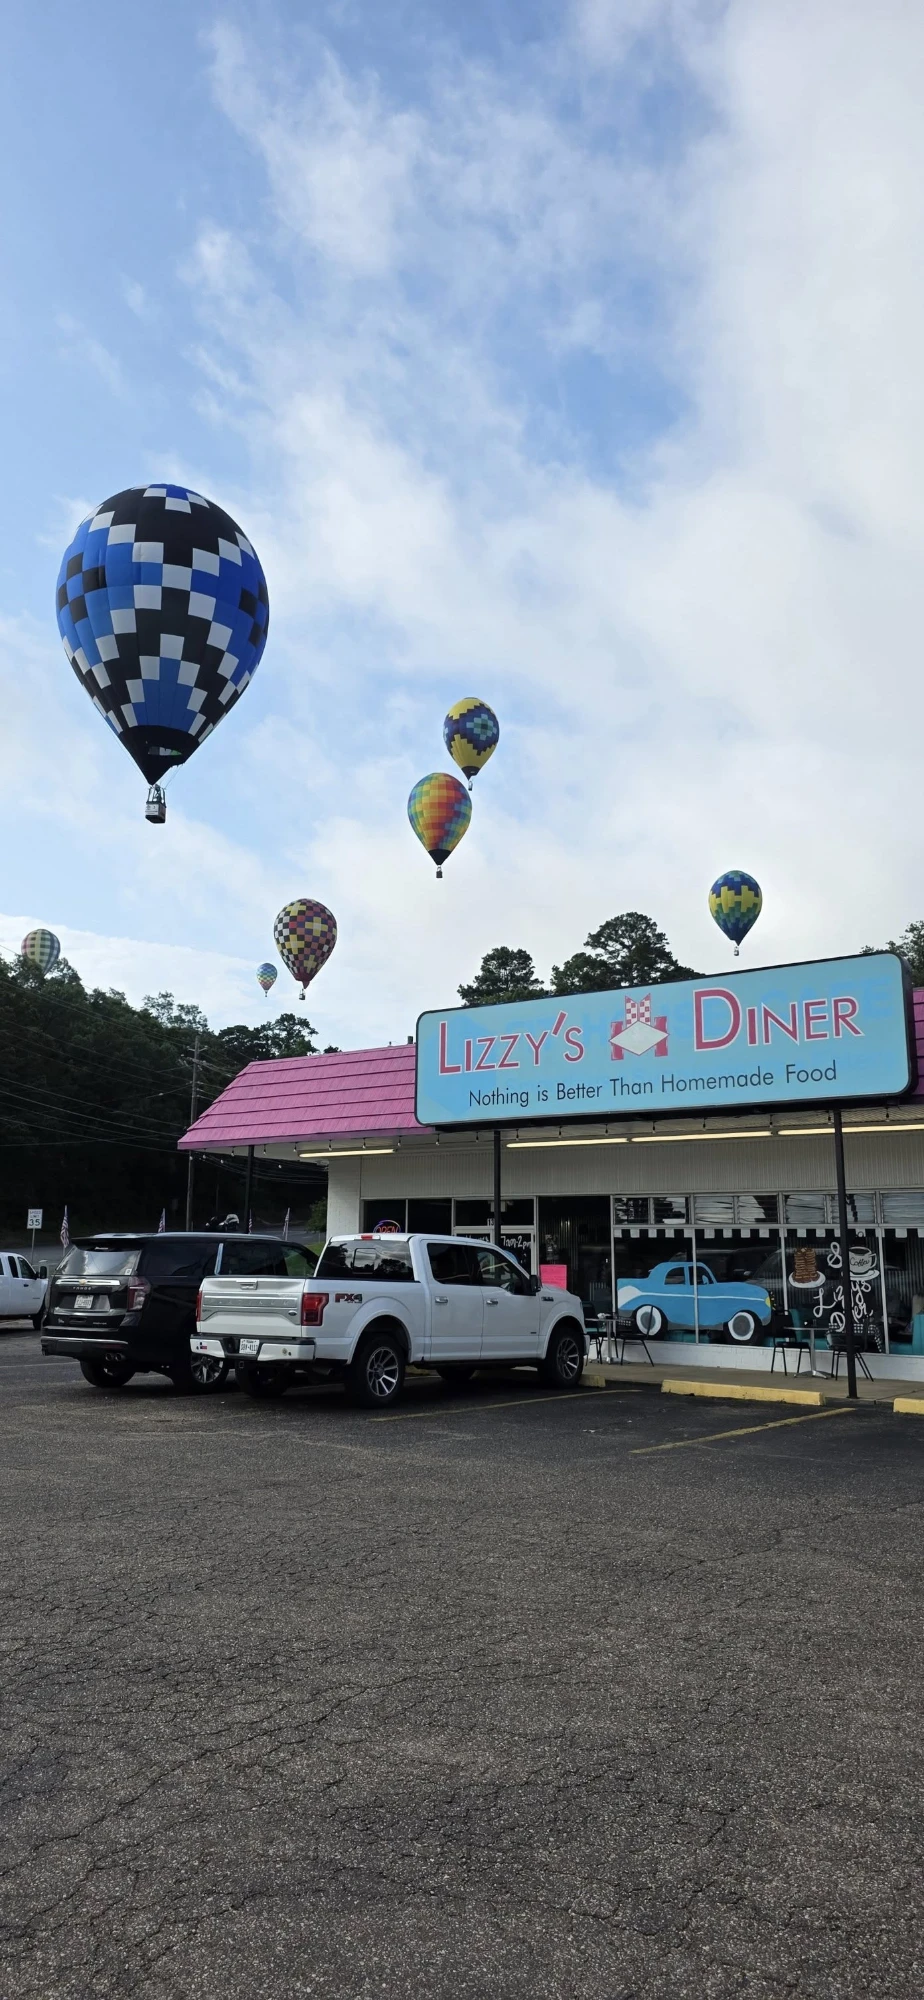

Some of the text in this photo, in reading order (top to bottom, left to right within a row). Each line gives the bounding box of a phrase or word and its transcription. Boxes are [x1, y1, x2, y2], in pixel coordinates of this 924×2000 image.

[439, 1010, 585, 1076] LIZZY'S
[693, 987, 865, 1052] DINER
[469, 1059, 837, 1107] Nothing is Better Than Homemade Food
[29, 1218, 41, 1227] 35
[376, 1225, 399, 1233] OPEN
[335, 1293, 363, 1303] FX4
